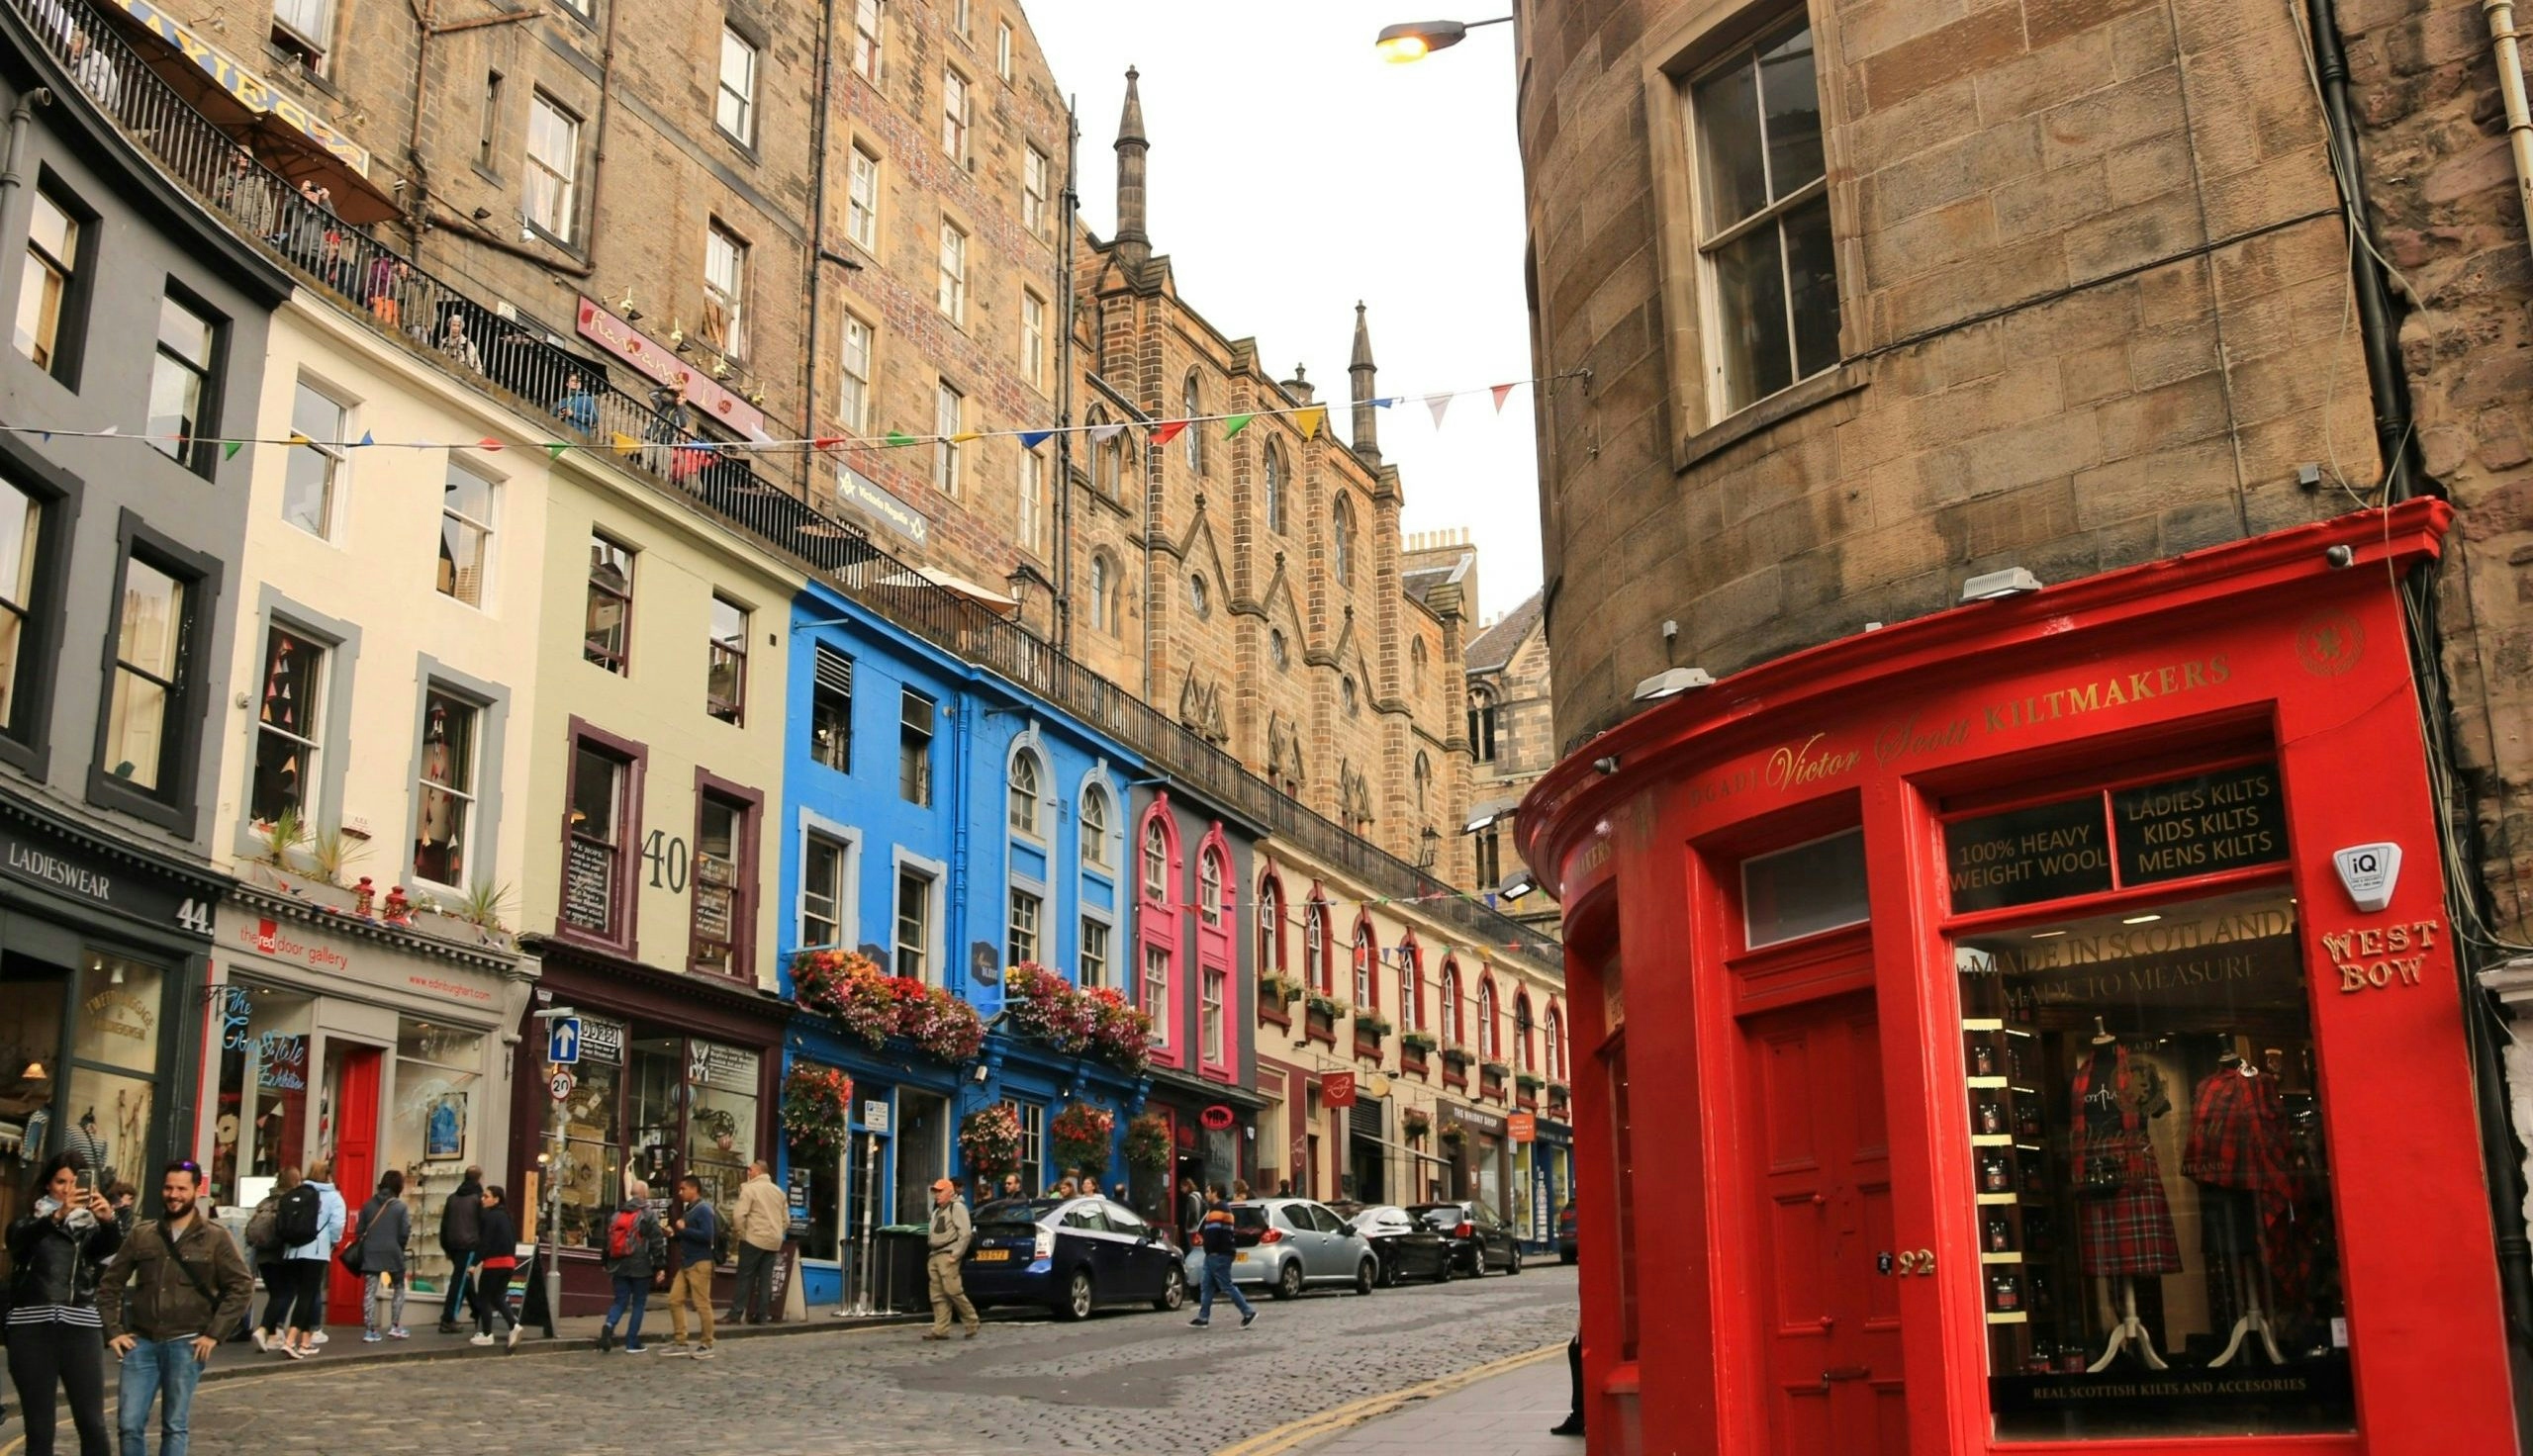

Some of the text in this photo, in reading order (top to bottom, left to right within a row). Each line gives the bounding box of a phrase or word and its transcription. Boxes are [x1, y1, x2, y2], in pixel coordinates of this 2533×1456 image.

[113, 0, 307, 133] AXIES
[858, 485, 909, 526] Victoria Regalia
[1765, 653, 2231, 791] Victor Scott KILTMAKERS
[2127, 775, 2271, 822] LADIES KILTS
[1958, 824, 2091, 866] 100% HEAVY
[2143, 805, 2260, 846] KIDS KILTS
[8, 842, 110, 901] LADIESWEAR
[641, 828, 688, 895] 40
[1949, 847, 2110, 892] WEIGHT WOOL
[2138, 830, 2274, 873] MENS KILTS
[2352, 854, 2378, 874] iQ
[239, 924, 348, 970] the red door gallery
[1969, 908, 2290, 981] MADE IN SCOTLAND
[2322, 920, 2438, 963] WEST
[2003, 953, 2262, 1012] MADE TO MEASURE
[2338, 953, 2427, 992] BOW
[552, 1078, 569, 1093] 20
[1454, 1106, 1498, 1129] THE WHISKY SHOP
[1899, 1248, 1935, 1275] 92
[2033, 1377, 2306, 1400] REAL SCOTTISH KILTS AND ACCESORIES
